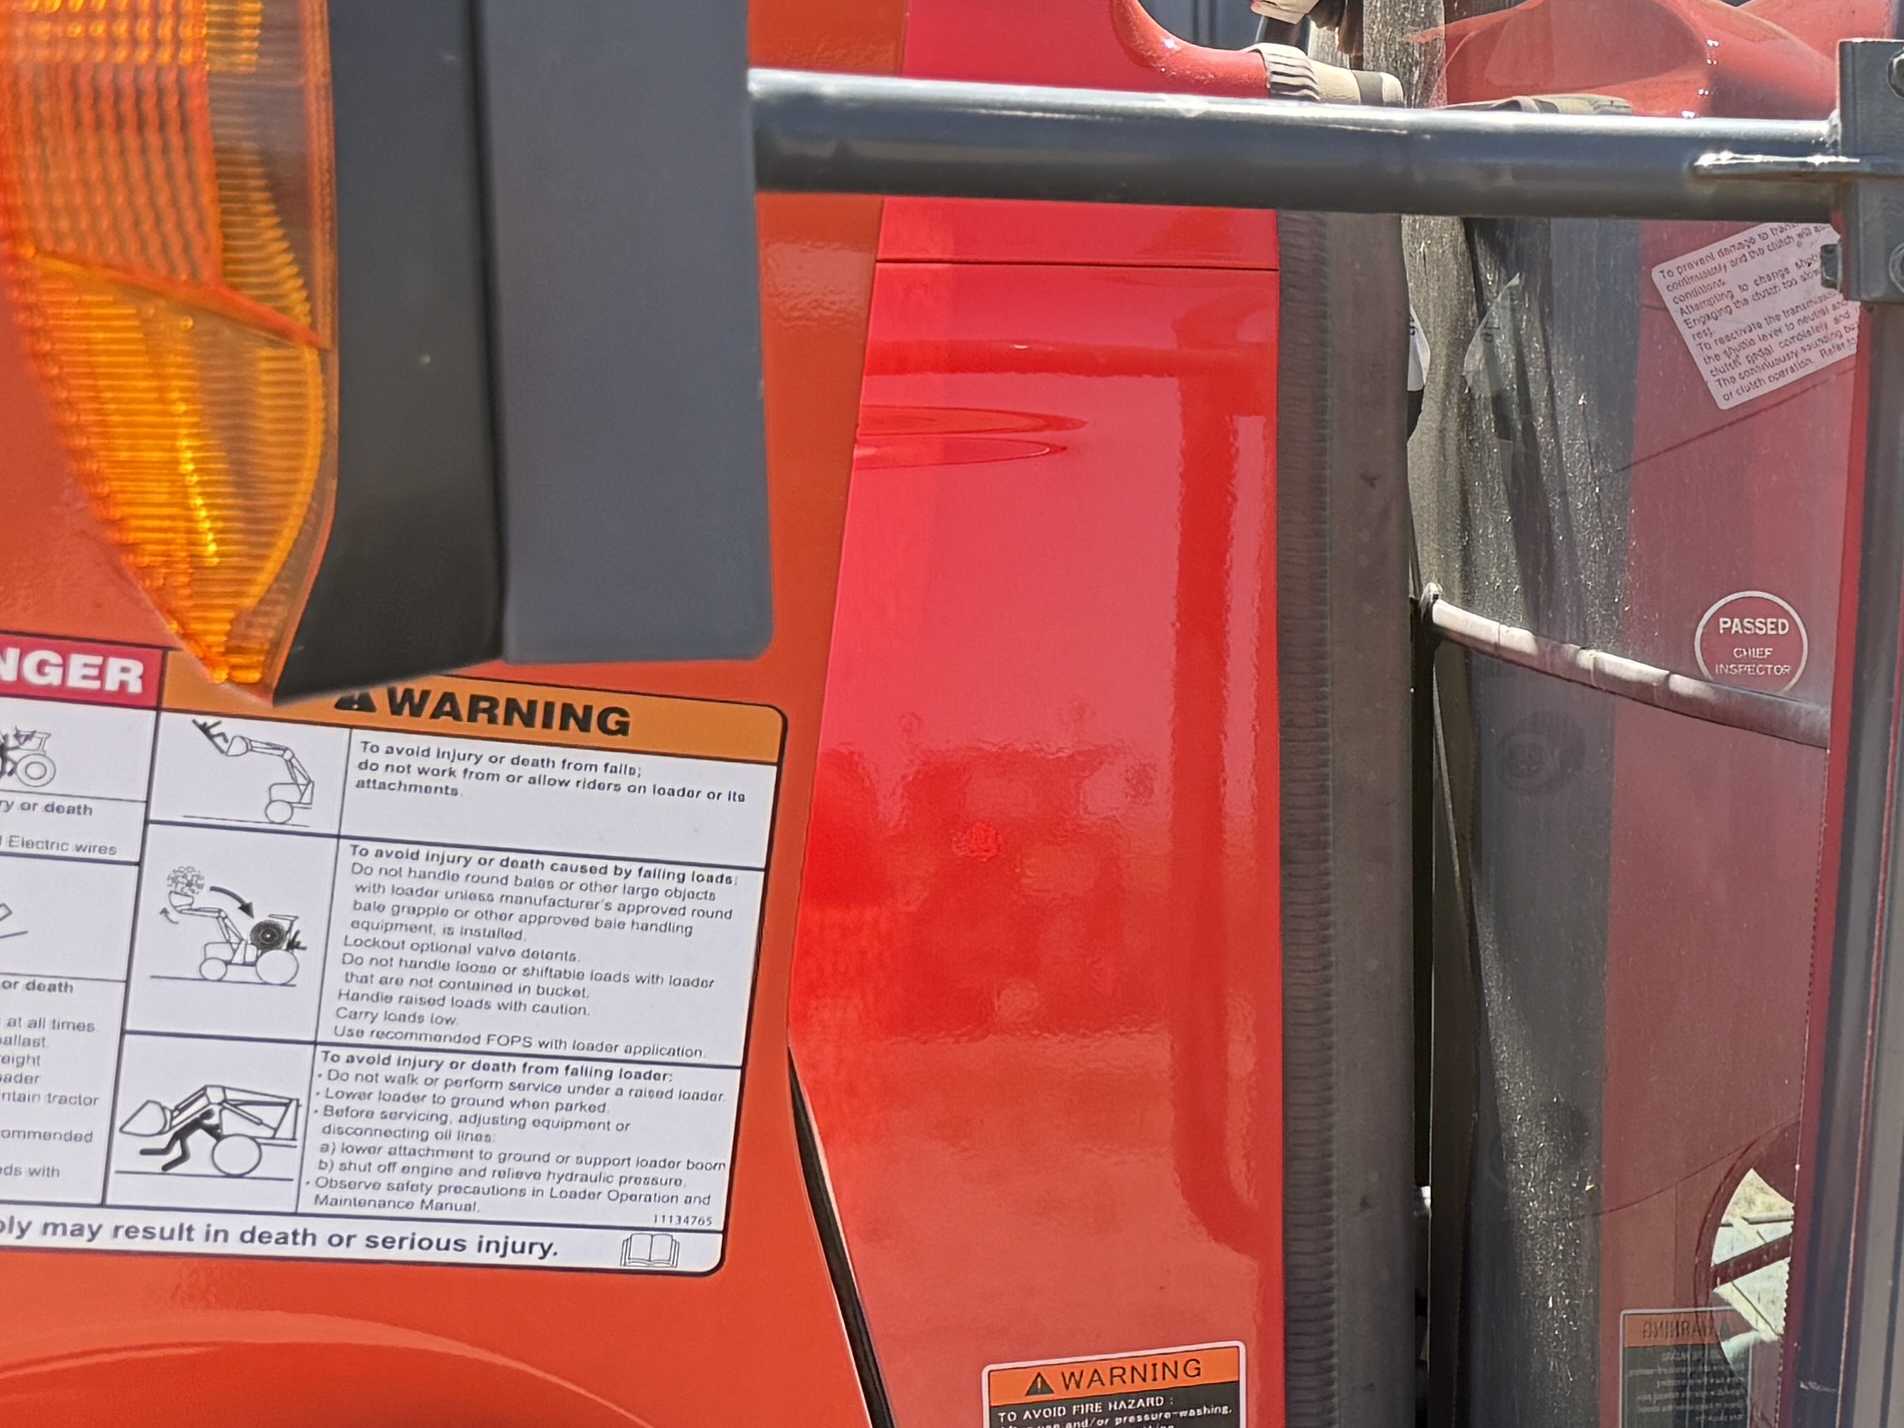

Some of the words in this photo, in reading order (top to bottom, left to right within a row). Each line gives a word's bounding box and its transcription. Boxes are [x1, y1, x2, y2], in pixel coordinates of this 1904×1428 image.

[1719, 617, 1790, 635] PASSED
[1733, 647, 1774, 659] CHIEF
[0, 646, 145, 694] NGER
[1715, 664, 1792, 676] INSPECTOR
[386, 685, 632, 737] WARNING
[359, 739, 381, 754] To
[384, 742, 432, 759] avoid
[434, 747, 484, 766] injury
[487, 754, 506, 765] or
[509, 753, 556, 770] death
[559, 757, 599, 773] from
[354, 776, 465, 797] attachments.
[356, 757, 380, 772] do
[383, 761, 412, 775] not
[415, 763, 458, 779] work
[461, 766, 501, 783] from
[504, 773, 523, 784] or
[526, 772, 571, 788] allow
[574, 776, 622, 793] riders
[626, 783, 647, 795] on
[651, 783, 702, 799] loader
[705, 790, 722, 801] or
[726, 789, 746, 803] its
[18, 800, 39, 812] or
[42, 800, 94, 817] death
[6, 833, 70, 852] Electric
[73, 842, 117, 856] wires
[348, 843, 370, 858] To
[373, 846, 420, 861] avoid
[424, 850, 473, 869] injury
[476, 856, 495, 867] or
[498, 855, 546, 871] death
[548, 860, 609, 876] caused
[612, 864, 633, 881] by
[636, 865, 687, 884] falling
[0, 979, 20, 991] or
[23, 978, 75, 994] death
[5, 1015, 23, 1028] at
[26, 1016, 47, 1030] all
[333, 1005, 380, 1025] Carry
[382, 1009, 426, 1025] loads
[332, 1024, 365, 1038] Use
[368, 1027, 482, 1046] recommended
[485, 1032, 534, 1049] FOPS
[536, 1036, 568, 1051] with
[571, 1038, 620, 1054] loader
[622, 1041, 709, 1060] application.
[0, 1052, 41, 1069] eight
[319, 1049, 341, 1063] To
[344, 1051, 392, 1067] avoid
[395, 1055, 445, 1073] injury
[448, 1059, 466, 1070] or
[469, 1058, 517, 1074] death
[520, 1060, 560, 1076] from
[563, 1063, 614, 1082] falling
[617, 1067, 673, 1082] loader:
[45, 1091, 100, 1107] tractor
[26, 1164, 61, 1178] with
[312, 1193, 415, 1210] Maintenance
[419, 1197, 481, 1213] Manual.
[652, 1213, 713, 1227] 11134765
[40, 1221, 103, 1243] may
[111, 1219, 196, 1242] result
[203, 1222, 230, 1243] in
[238, 1224, 318, 1247] death
[326, 1232, 357, 1249] or
[363, 1229, 468, 1253] serious
[475, 1233, 560, 1261] injury.
[1060, 1358, 1202, 1391] WARNING
[998, 1410, 1017, 1423] TO
[1022, 1405, 1066, 1420] AVOID
[1072, 1402, 1102, 1415] FIRE
[1108, 1395, 1163, 1411] HAZARD
